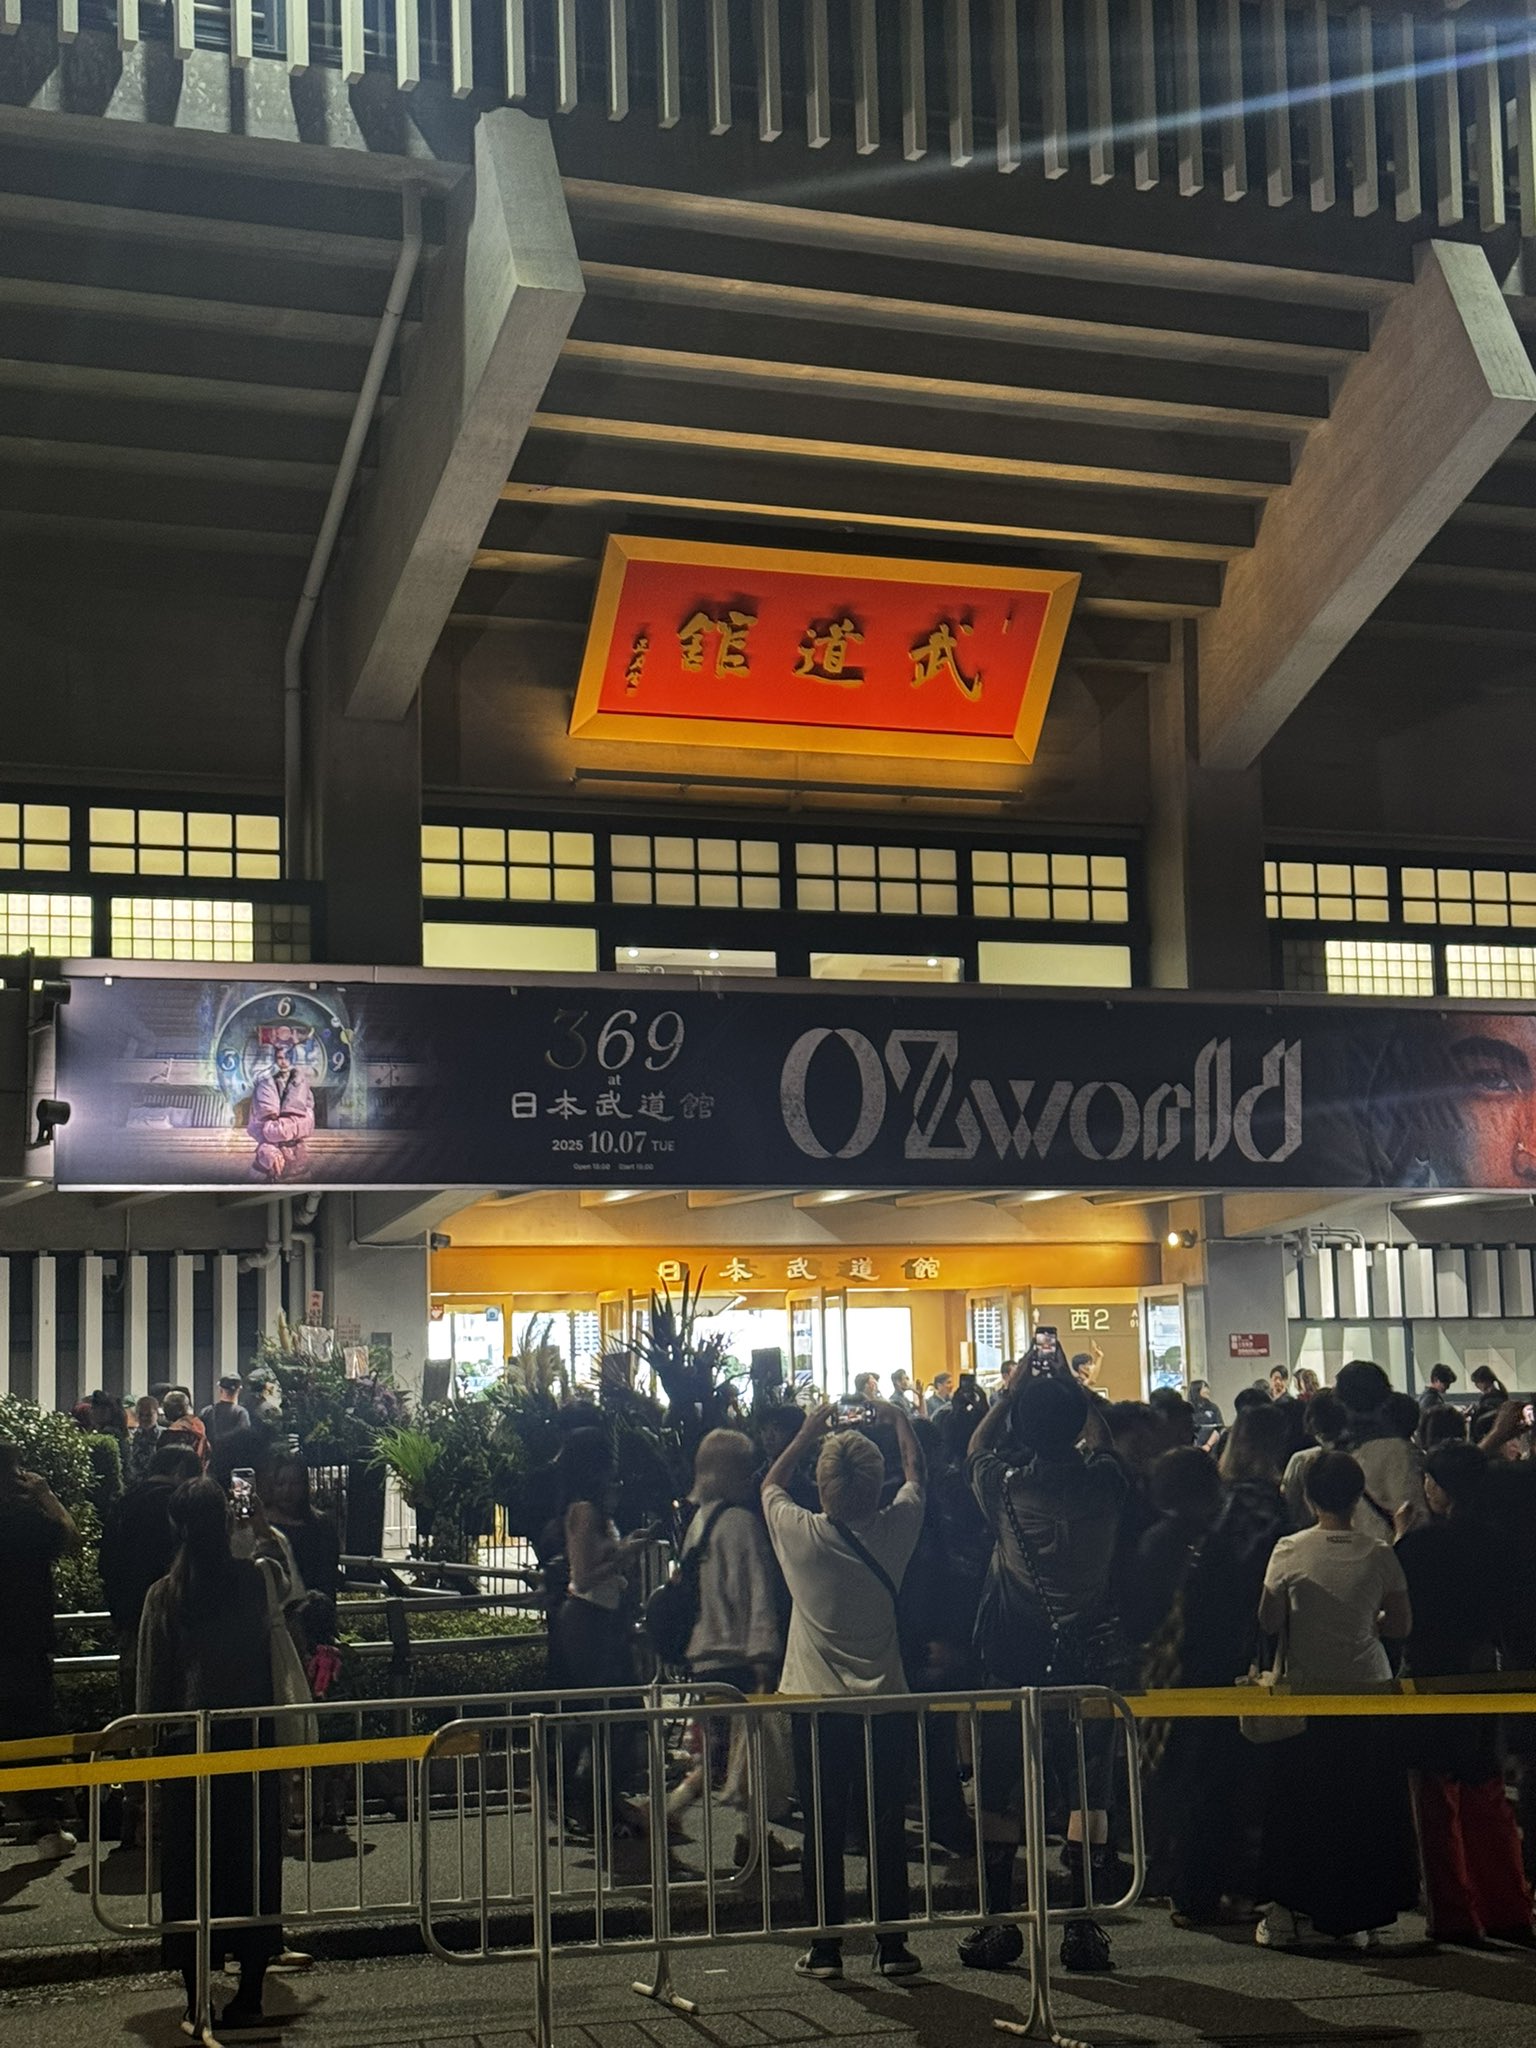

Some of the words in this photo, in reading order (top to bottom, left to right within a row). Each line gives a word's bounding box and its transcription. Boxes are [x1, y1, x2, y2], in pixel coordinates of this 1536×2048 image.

[678, 611, 982, 702] 武道館
[277, 996, 292, 1017] 6
[545, 1009, 686, 1071] 369
[221, 1051, 236, 1072] 3
[332, 1051, 345, 1072] 9
[607, 1074, 622, 1086] at
[511, 1089, 715, 1122] 日本武道館
[552, 1139, 584, 1151] 2025
[588, 1130, 647, 1153] 10.07
[651, 1140, 675, 1151] TUE
[658, 1257, 940, 1282] 日本武道館
[1070, 1308, 1110, 1331] 西2
